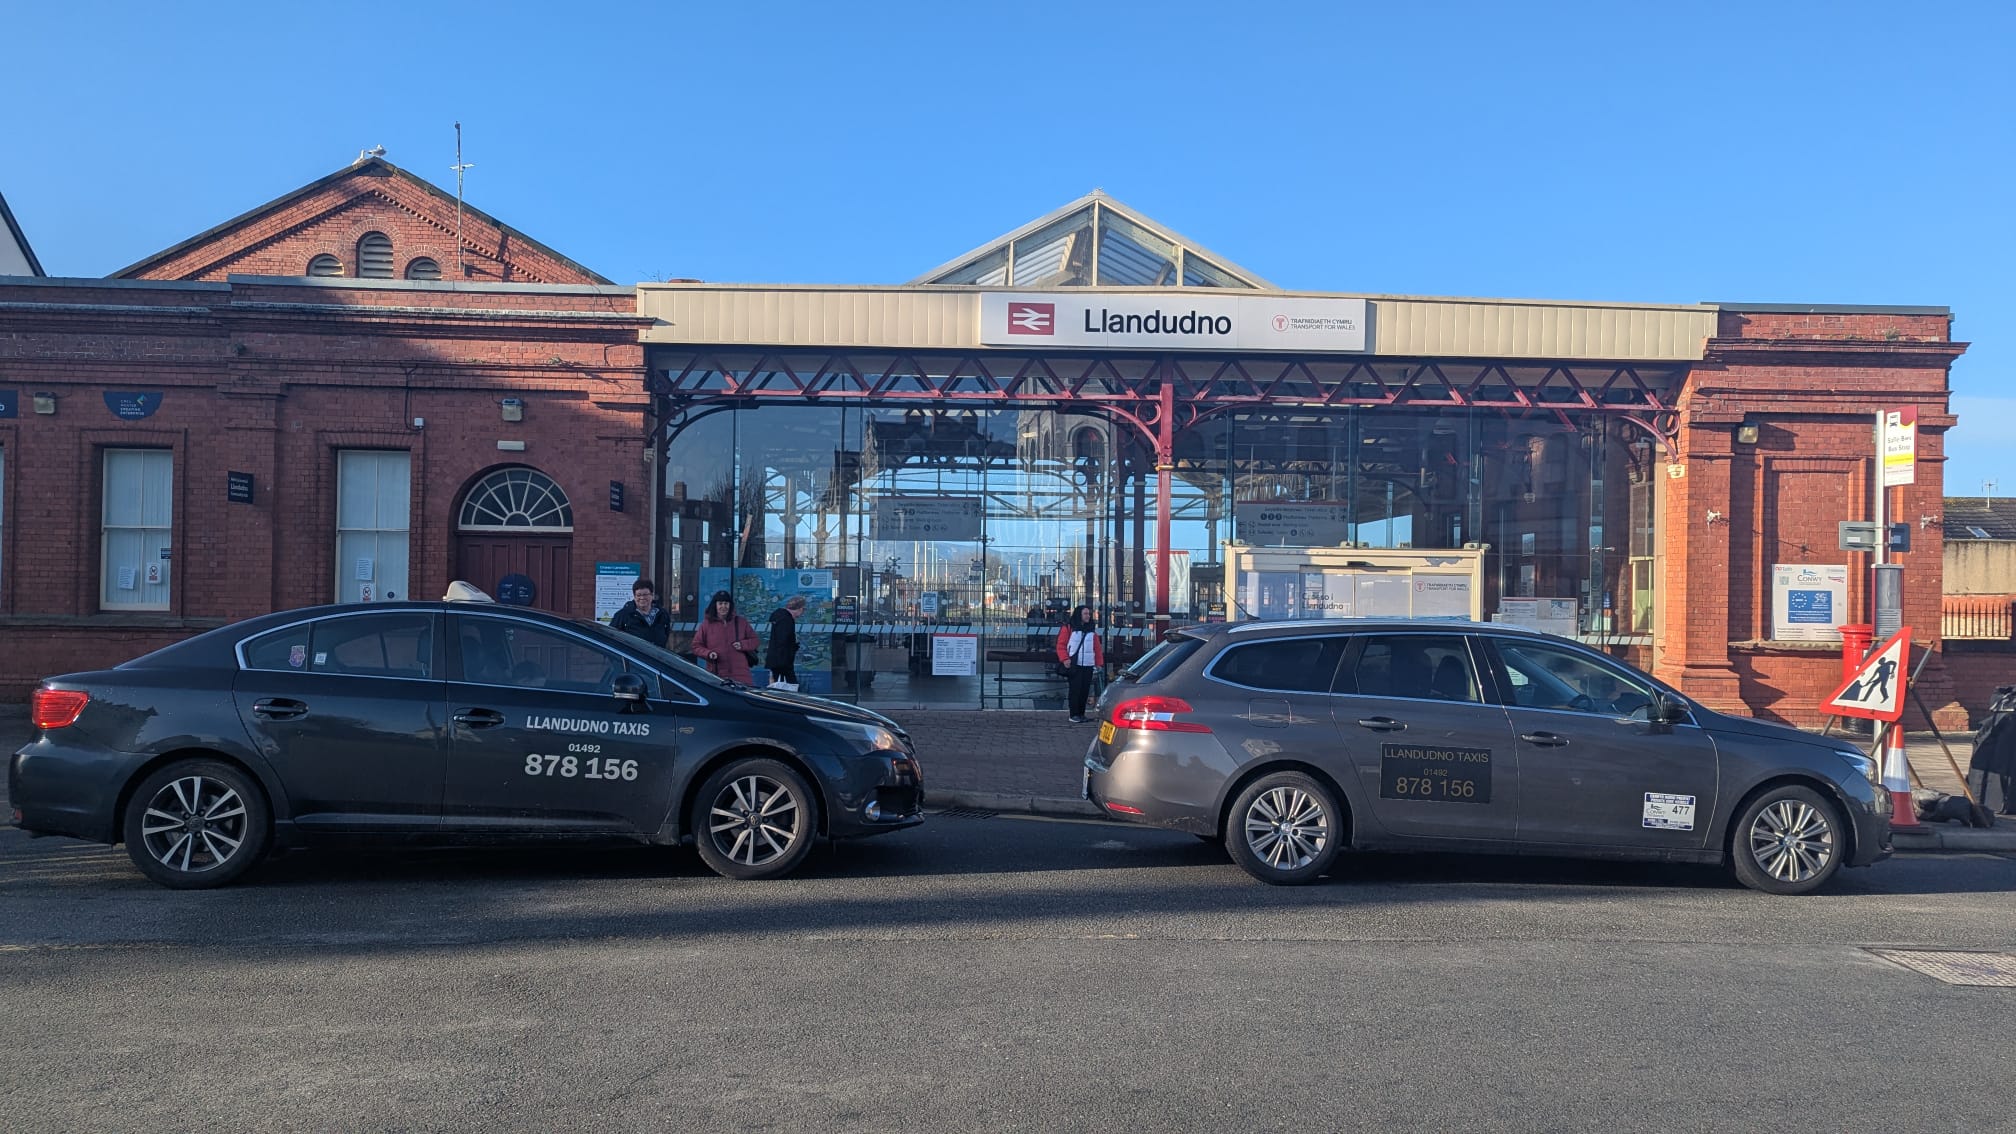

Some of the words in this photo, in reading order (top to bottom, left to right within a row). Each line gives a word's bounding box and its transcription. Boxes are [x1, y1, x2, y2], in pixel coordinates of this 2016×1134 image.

[1084, 308, 1232, 335] Llandudno
[1797, 574, 1822, 582] CONWY
[526, 715, 609, 733] LLANDUDNO
[612, 721, 650, 736] TAXIS
[568, 743, 601, 754] 01492
[1384, 748, 1455, 761] LLANDUDNO
[1457, 751, 1489, 764] TAXIS
[524, 753, 578, 778] 878
[584, 757, 639, 781] 156
[1423, 768, 1448, 777] 01492
[1396, 777, 1432, 795] 878
[1440, 779, 1475, 798] 156
[1672, 805, 1690, 815] 477
